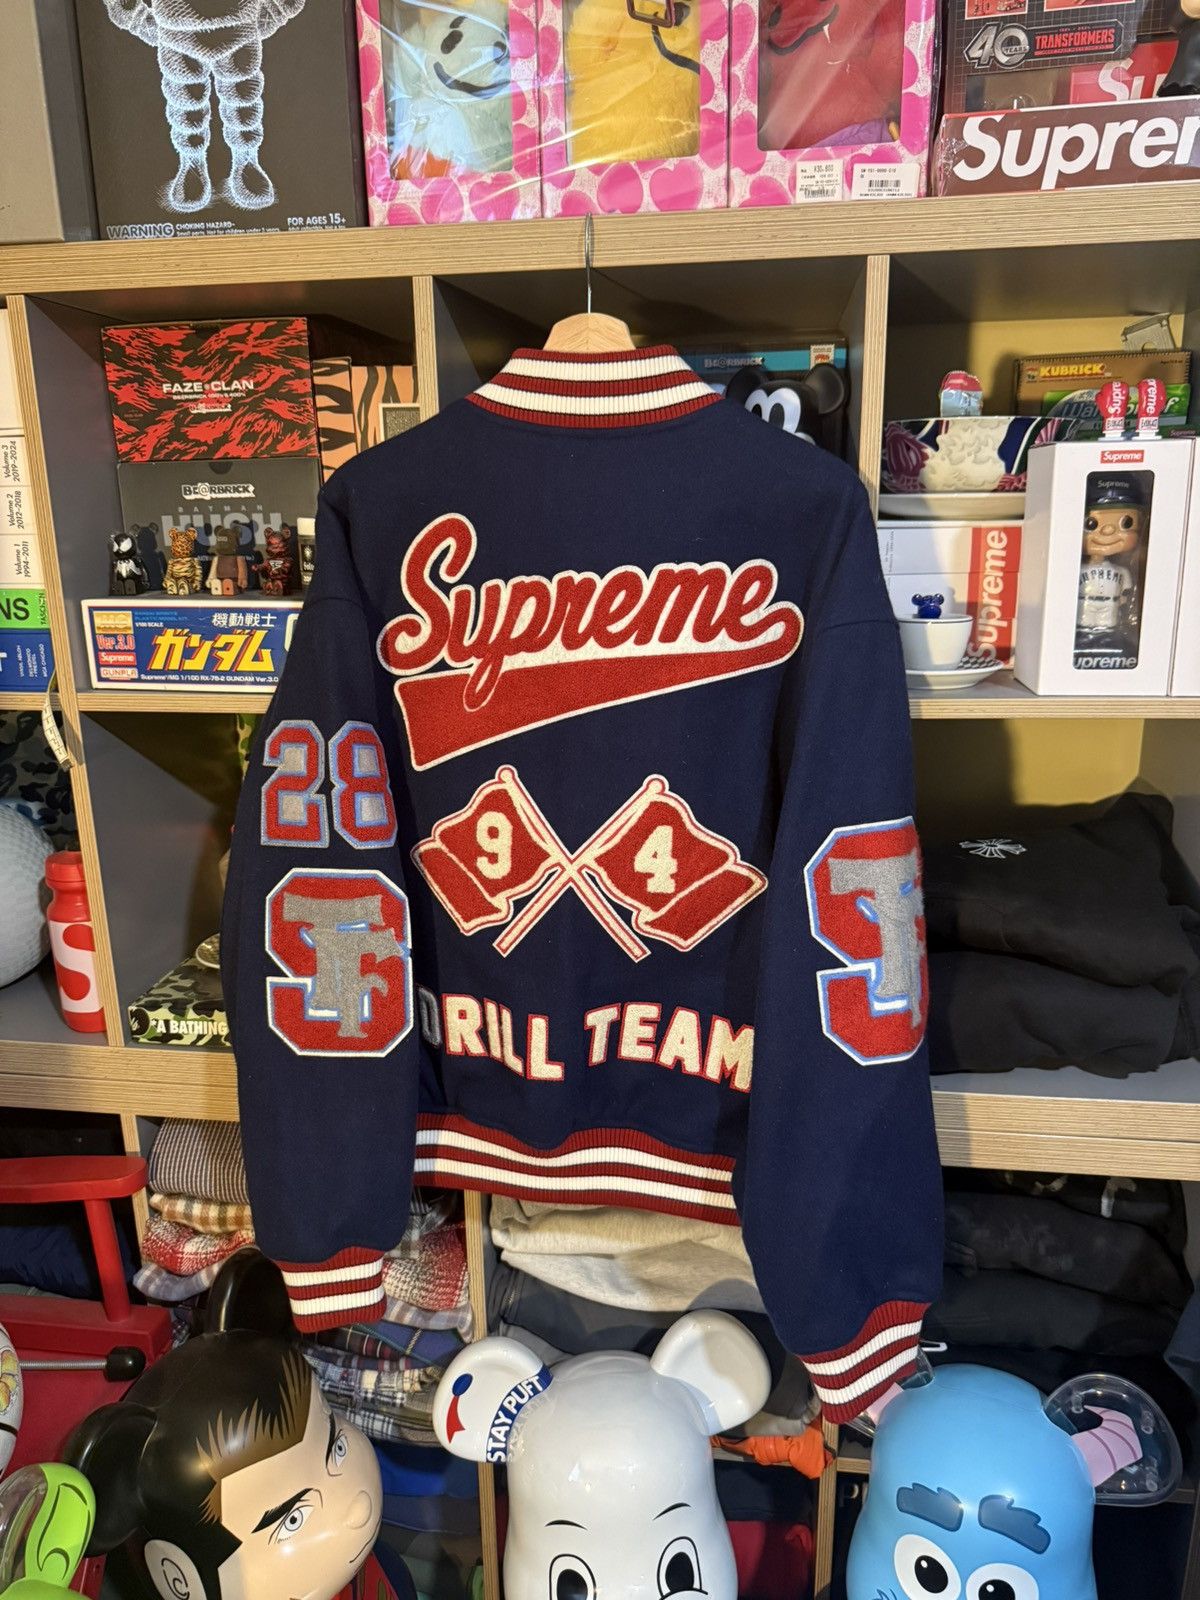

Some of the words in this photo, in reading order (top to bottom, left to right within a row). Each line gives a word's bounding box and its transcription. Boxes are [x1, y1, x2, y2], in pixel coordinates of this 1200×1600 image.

[965, 23, 1029, 67] 40
[1034, 28, 1116, 50] TRANSFORMERS
[1004, 45, 1029, 54] YEARS
[176, 222, 205, 231] CHOKING
[287, 217, 303, 226] FOR
[306, 216, 327, 225] AGES
[329, 213, 347, 225] 15+
[106, 223, 174, 239] WARNING
[1040, 363, 1105, 377] KUBRICK
[162, 382, 204, 394] FAZE
[211, 380, 254, 391] CLAN
[1103, 451, 1142, 463] Supreme
[182, 482, 256, 500] BE@RBRICK
[1097, 480, 1130, 488] Supreme
[7, 500, 15, 527] Volume
[161, 512, 284, 547] HUSH
[14, 548, 23, 576] Volume
[969, 530, 1008, 659] Supreme
[211, 612, 277, 628] 機動戦士
[377, 512, 804, 712] Supreme
[96, 634, 136, 650] Ver.3.0
[147, 629, 275, 672] ガンダム
[39, 643, 47, 667] CHICAGO
[101, 652, 134, 664] Supreme
[1074, 655, 1137, 669] upreme
[102, 668, 137, 677] GUNPLA
[201, 674, 224, 682] RX-78-2
[261, 719, 398, 850] 28
[476, 811, 513, 880] 9
[634, 824, 678, 894] 4
[156, 1020, 167, 1034] A
[169, 1020, 228, 1036] BATHING
[418, 985, 565, 1083] DRILL
[584, 1001, 755, 1094] TEAM
[486, 1410, 513, 1463] STAY
[503, 1375, 544, 1415] PUFT
